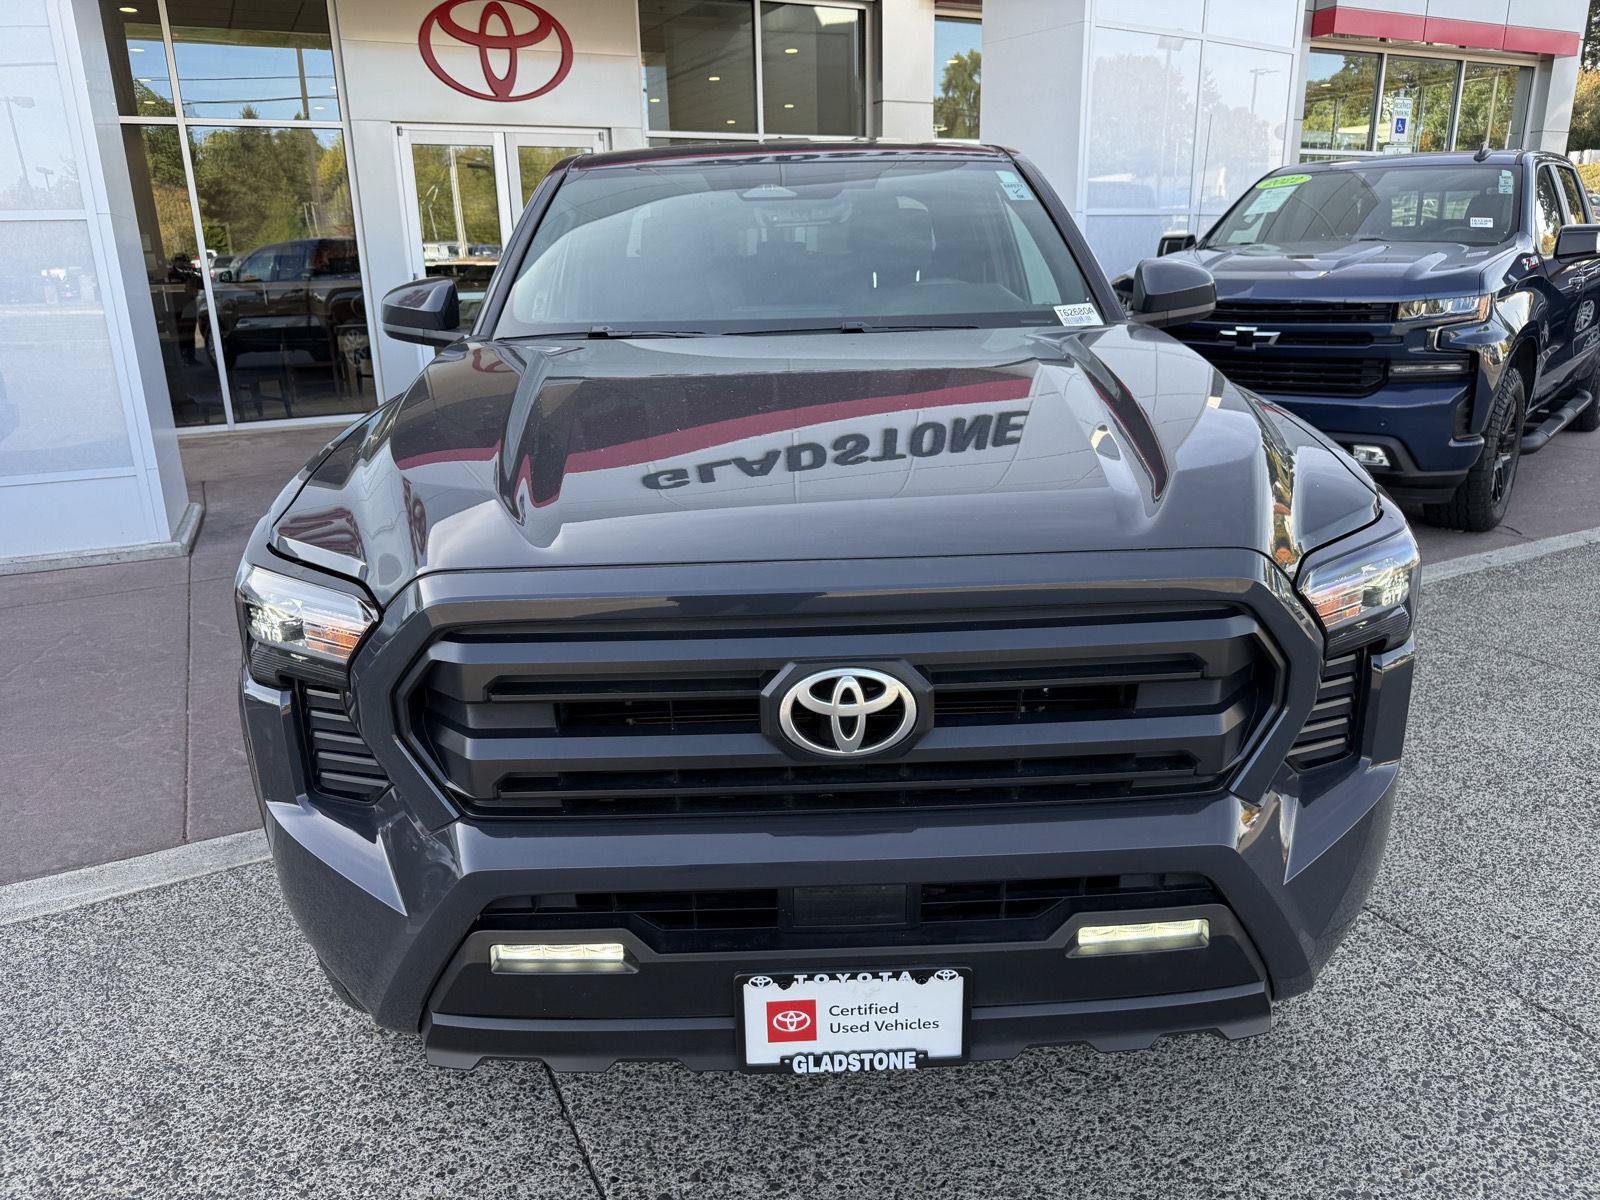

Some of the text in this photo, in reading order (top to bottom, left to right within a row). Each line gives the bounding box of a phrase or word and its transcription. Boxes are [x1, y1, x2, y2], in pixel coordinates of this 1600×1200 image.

[793, 971, 914, 984] TOYOTA
[829, 1002, 899, 1017] Certified
[829, 1018, 940, 1034] Used Vehicles
[792, 1050, 917, 1074] GLADSTONE
